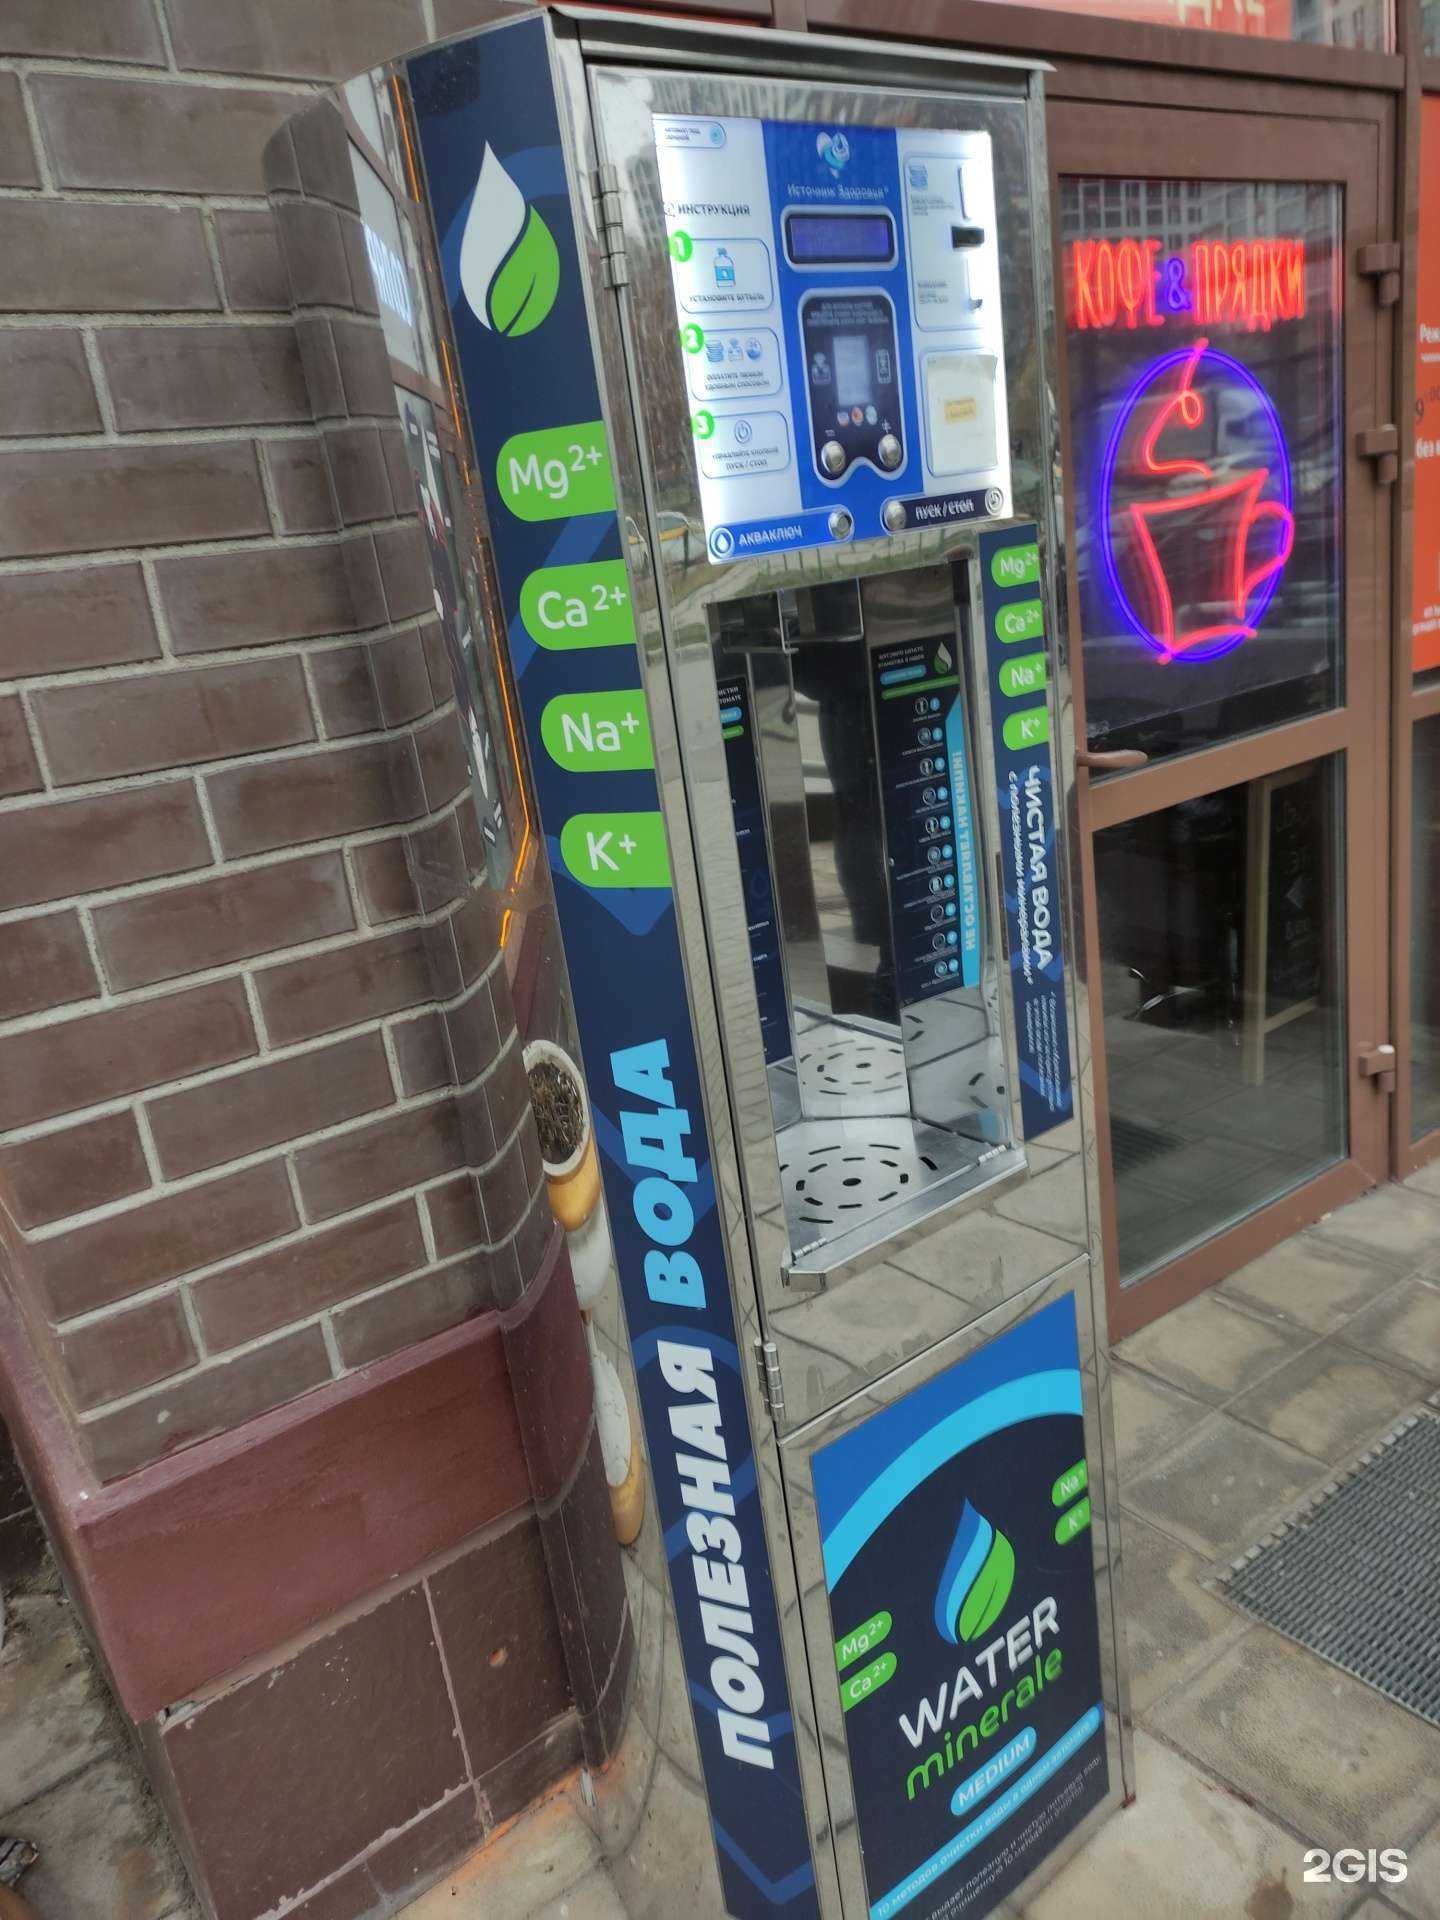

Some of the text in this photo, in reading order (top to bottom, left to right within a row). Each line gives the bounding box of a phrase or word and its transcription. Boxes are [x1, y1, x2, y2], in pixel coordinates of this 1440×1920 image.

[678, 203, 750, 217] ИНСТРУКЦИЯ
[1073, 238, 1305, 331] КОФЕ & ПРЯДКИ
[739, 525, 803, 547] АКВАКЛЮЧ
[1025, 765, 1048, 882] ЧИСТАЯ
[1031, 886, 1053, 970] ВОДА
[610, 1038, 774, 1769] ПОЛЕЗНАЯ ВОДА
[899, 1596, 1060, 1748] WATER
[907, 1648, 1064, 1800] minerale
[958, 1734, 1030, 1807] MEDIUM
[878, 1902, 890, 1917] 10
[892, 1862, 938, 1906] методов
[940, 1823, 984, 1866] очистки
[984, 1798, 1011, 1828] воды
